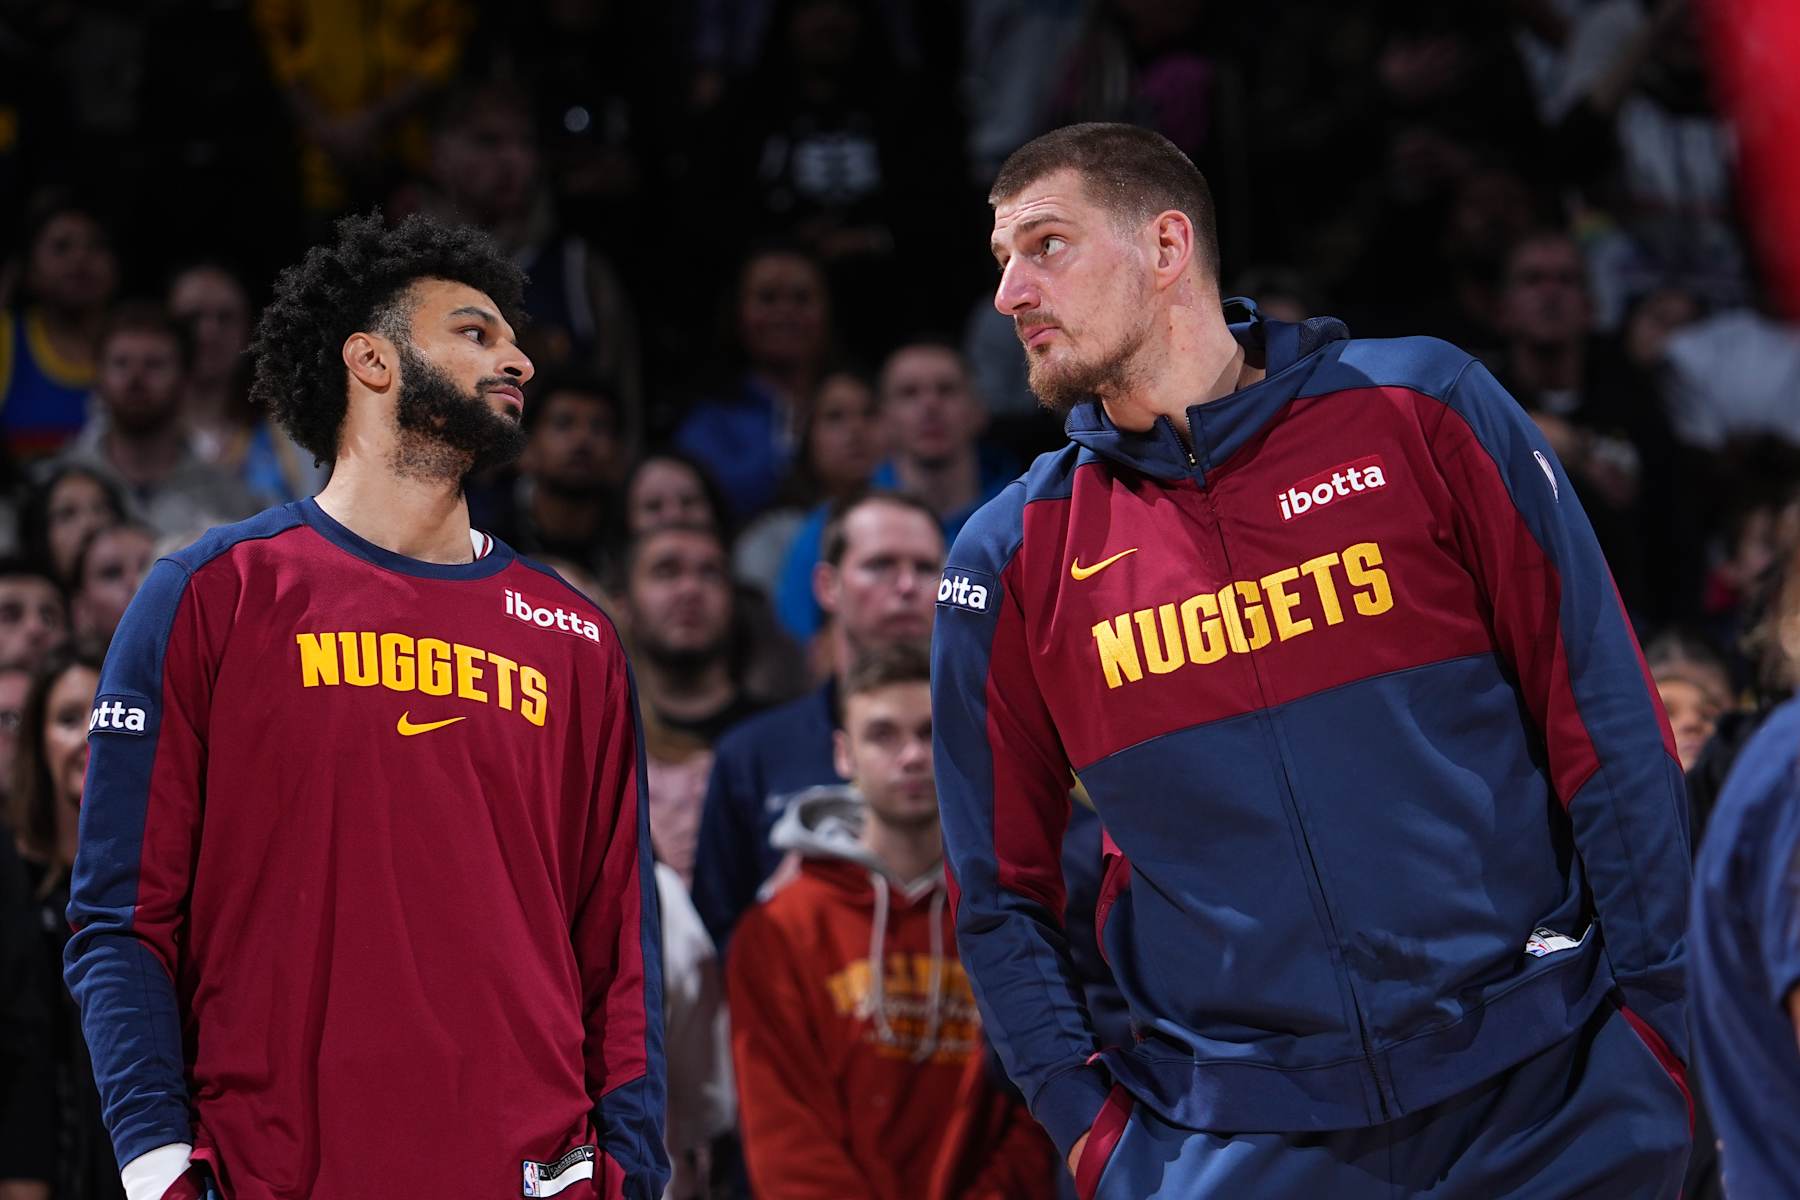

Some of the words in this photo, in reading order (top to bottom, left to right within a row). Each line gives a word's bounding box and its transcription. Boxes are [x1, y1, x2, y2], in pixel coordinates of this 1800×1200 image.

[1278, 466, 1386, 520] ibotta
[504, 589, 600, 643] ibotta
[937, 573, 988, 609] otta
[1091, 542, 1394, 689] NUGGETS
[296, 631, 548, 727] NUGGETS
